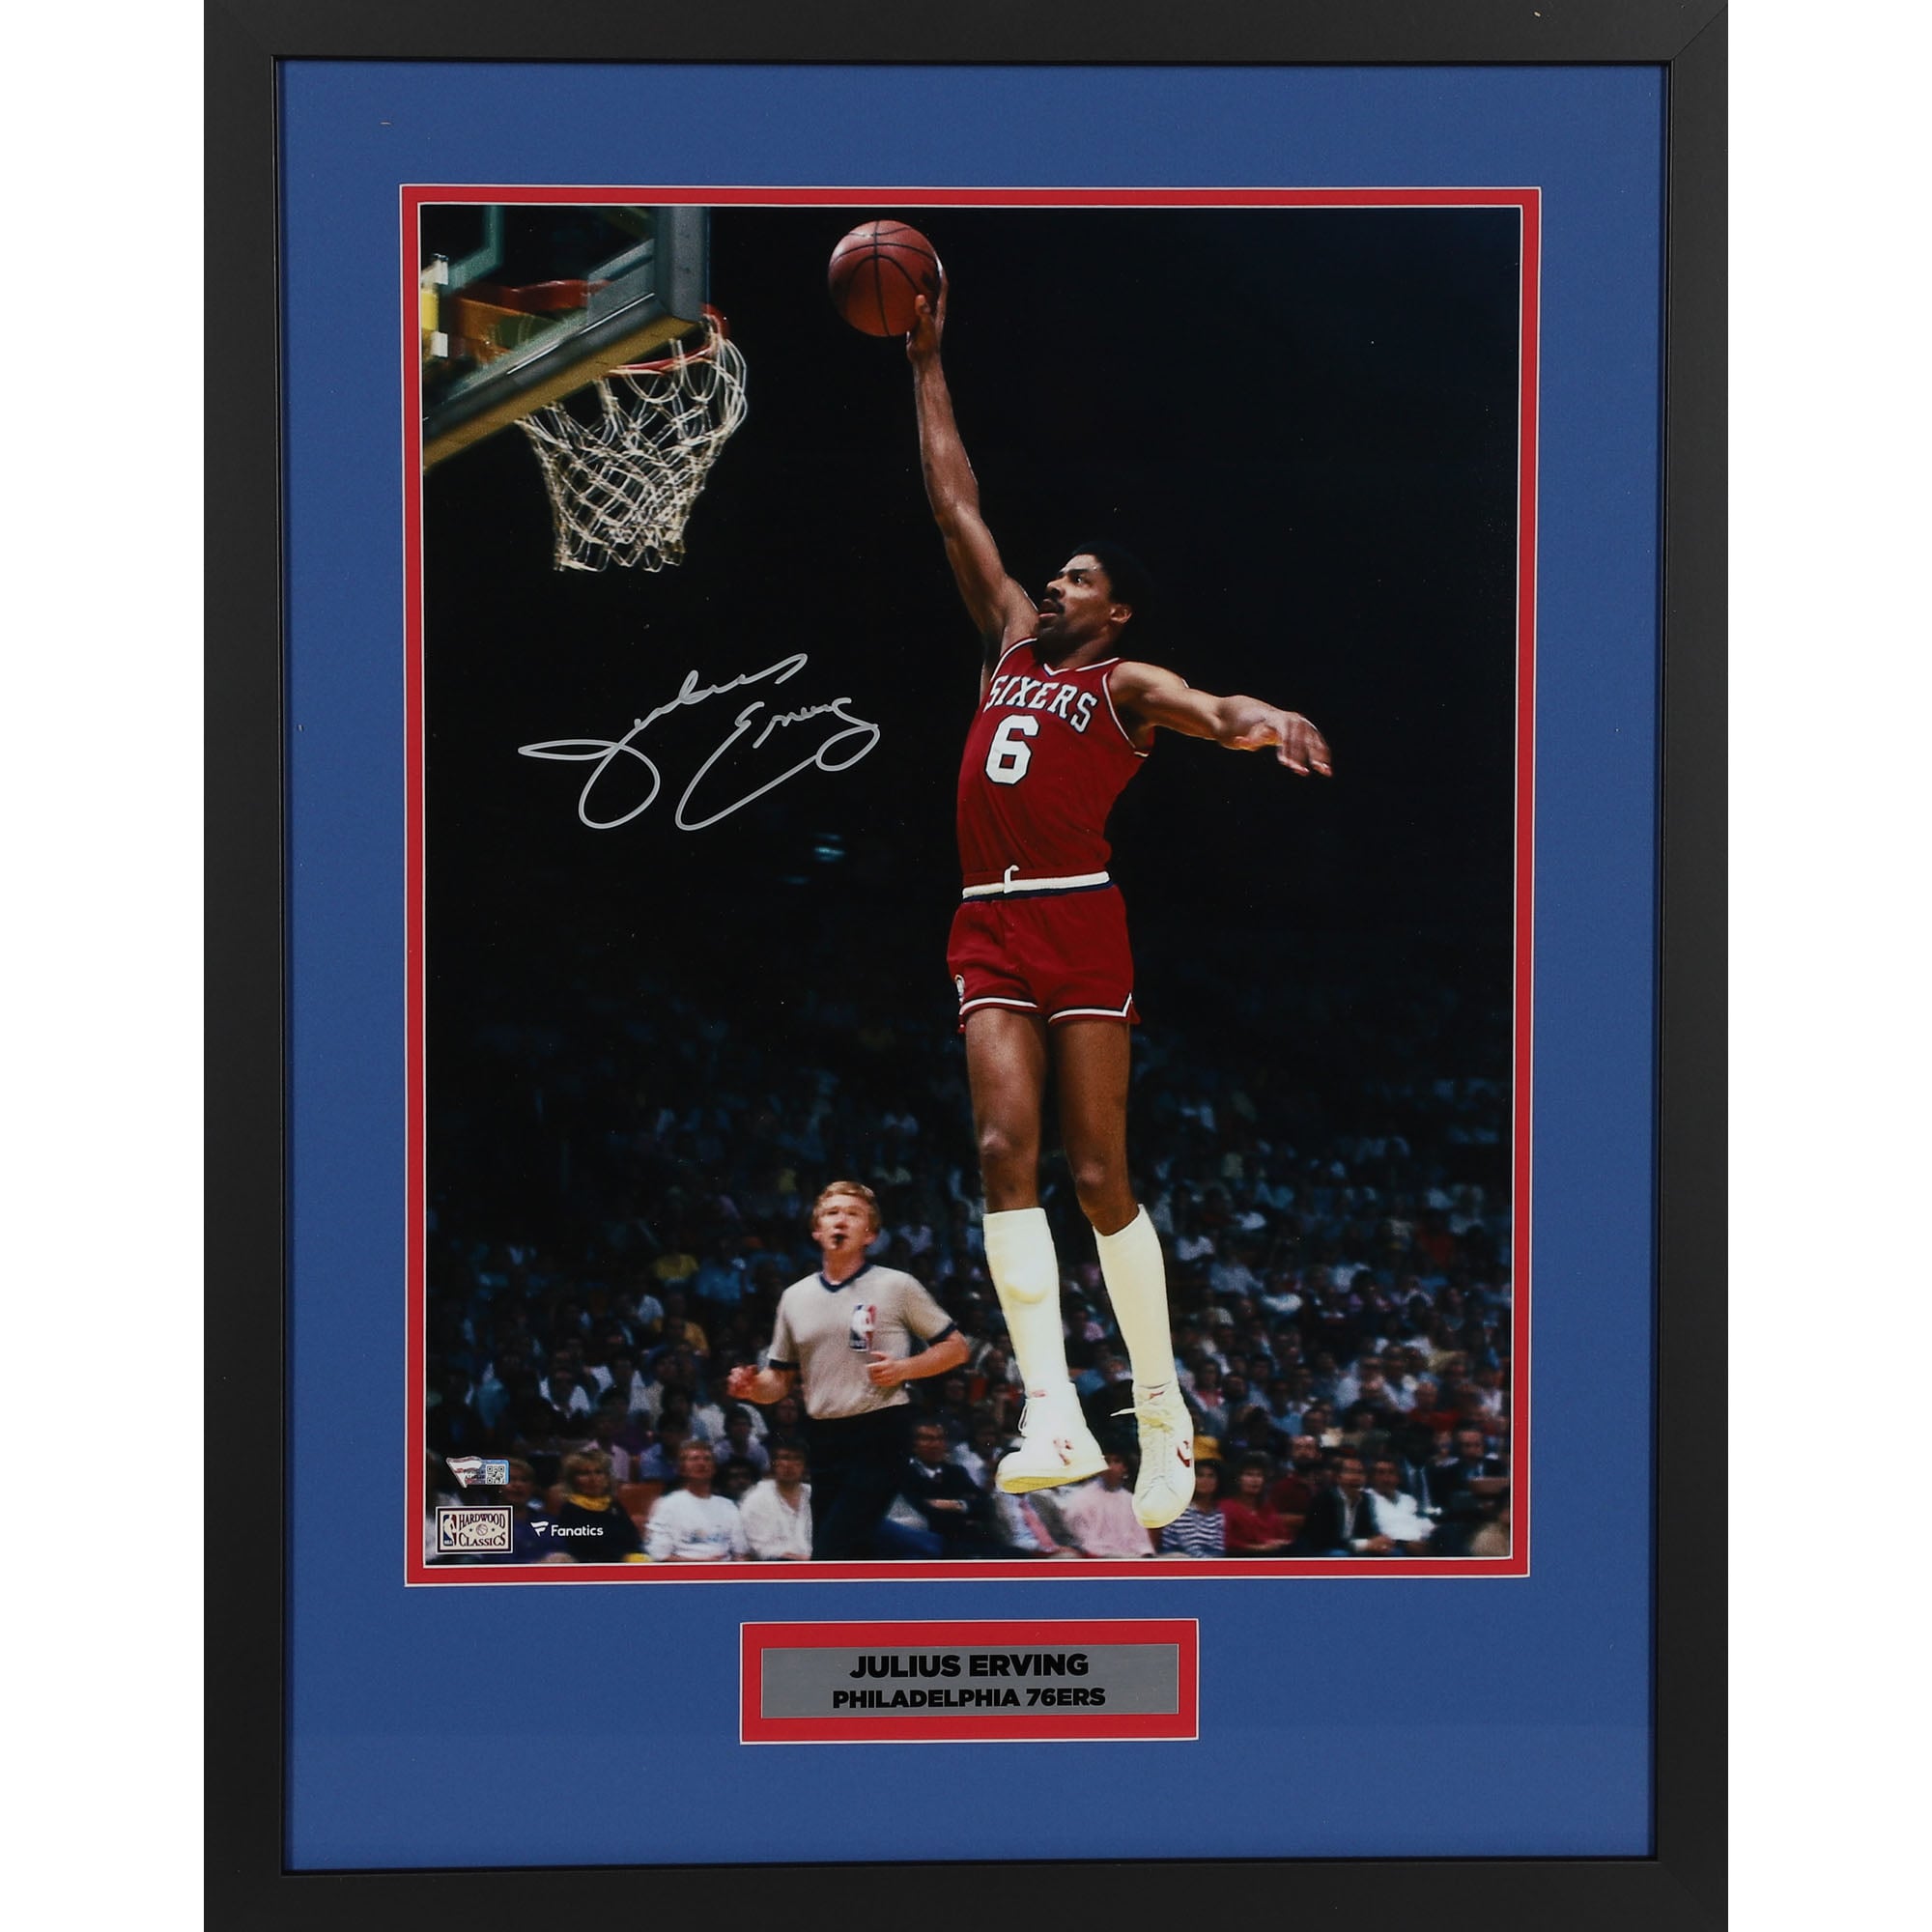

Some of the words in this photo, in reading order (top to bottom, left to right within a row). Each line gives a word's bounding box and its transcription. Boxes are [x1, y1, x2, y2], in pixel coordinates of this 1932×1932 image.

[983, 674, 1098, 734] SIXERS
[985, 713, 1040, 785] 6
[459, 1513, 505, 1530] HARDWOOD
[551, 1524, 604, 1537] Fanatics
[458, 1532, 506, 1547] CLASSICS
[850, 1655, 961, 1678] JULIUS
[969, 1653, 1090, 1678] ERVING
[833, 1689, 1020, 1708] PHILADELPHIA
[1026, 1688, 1106, 1707] 76ERS
